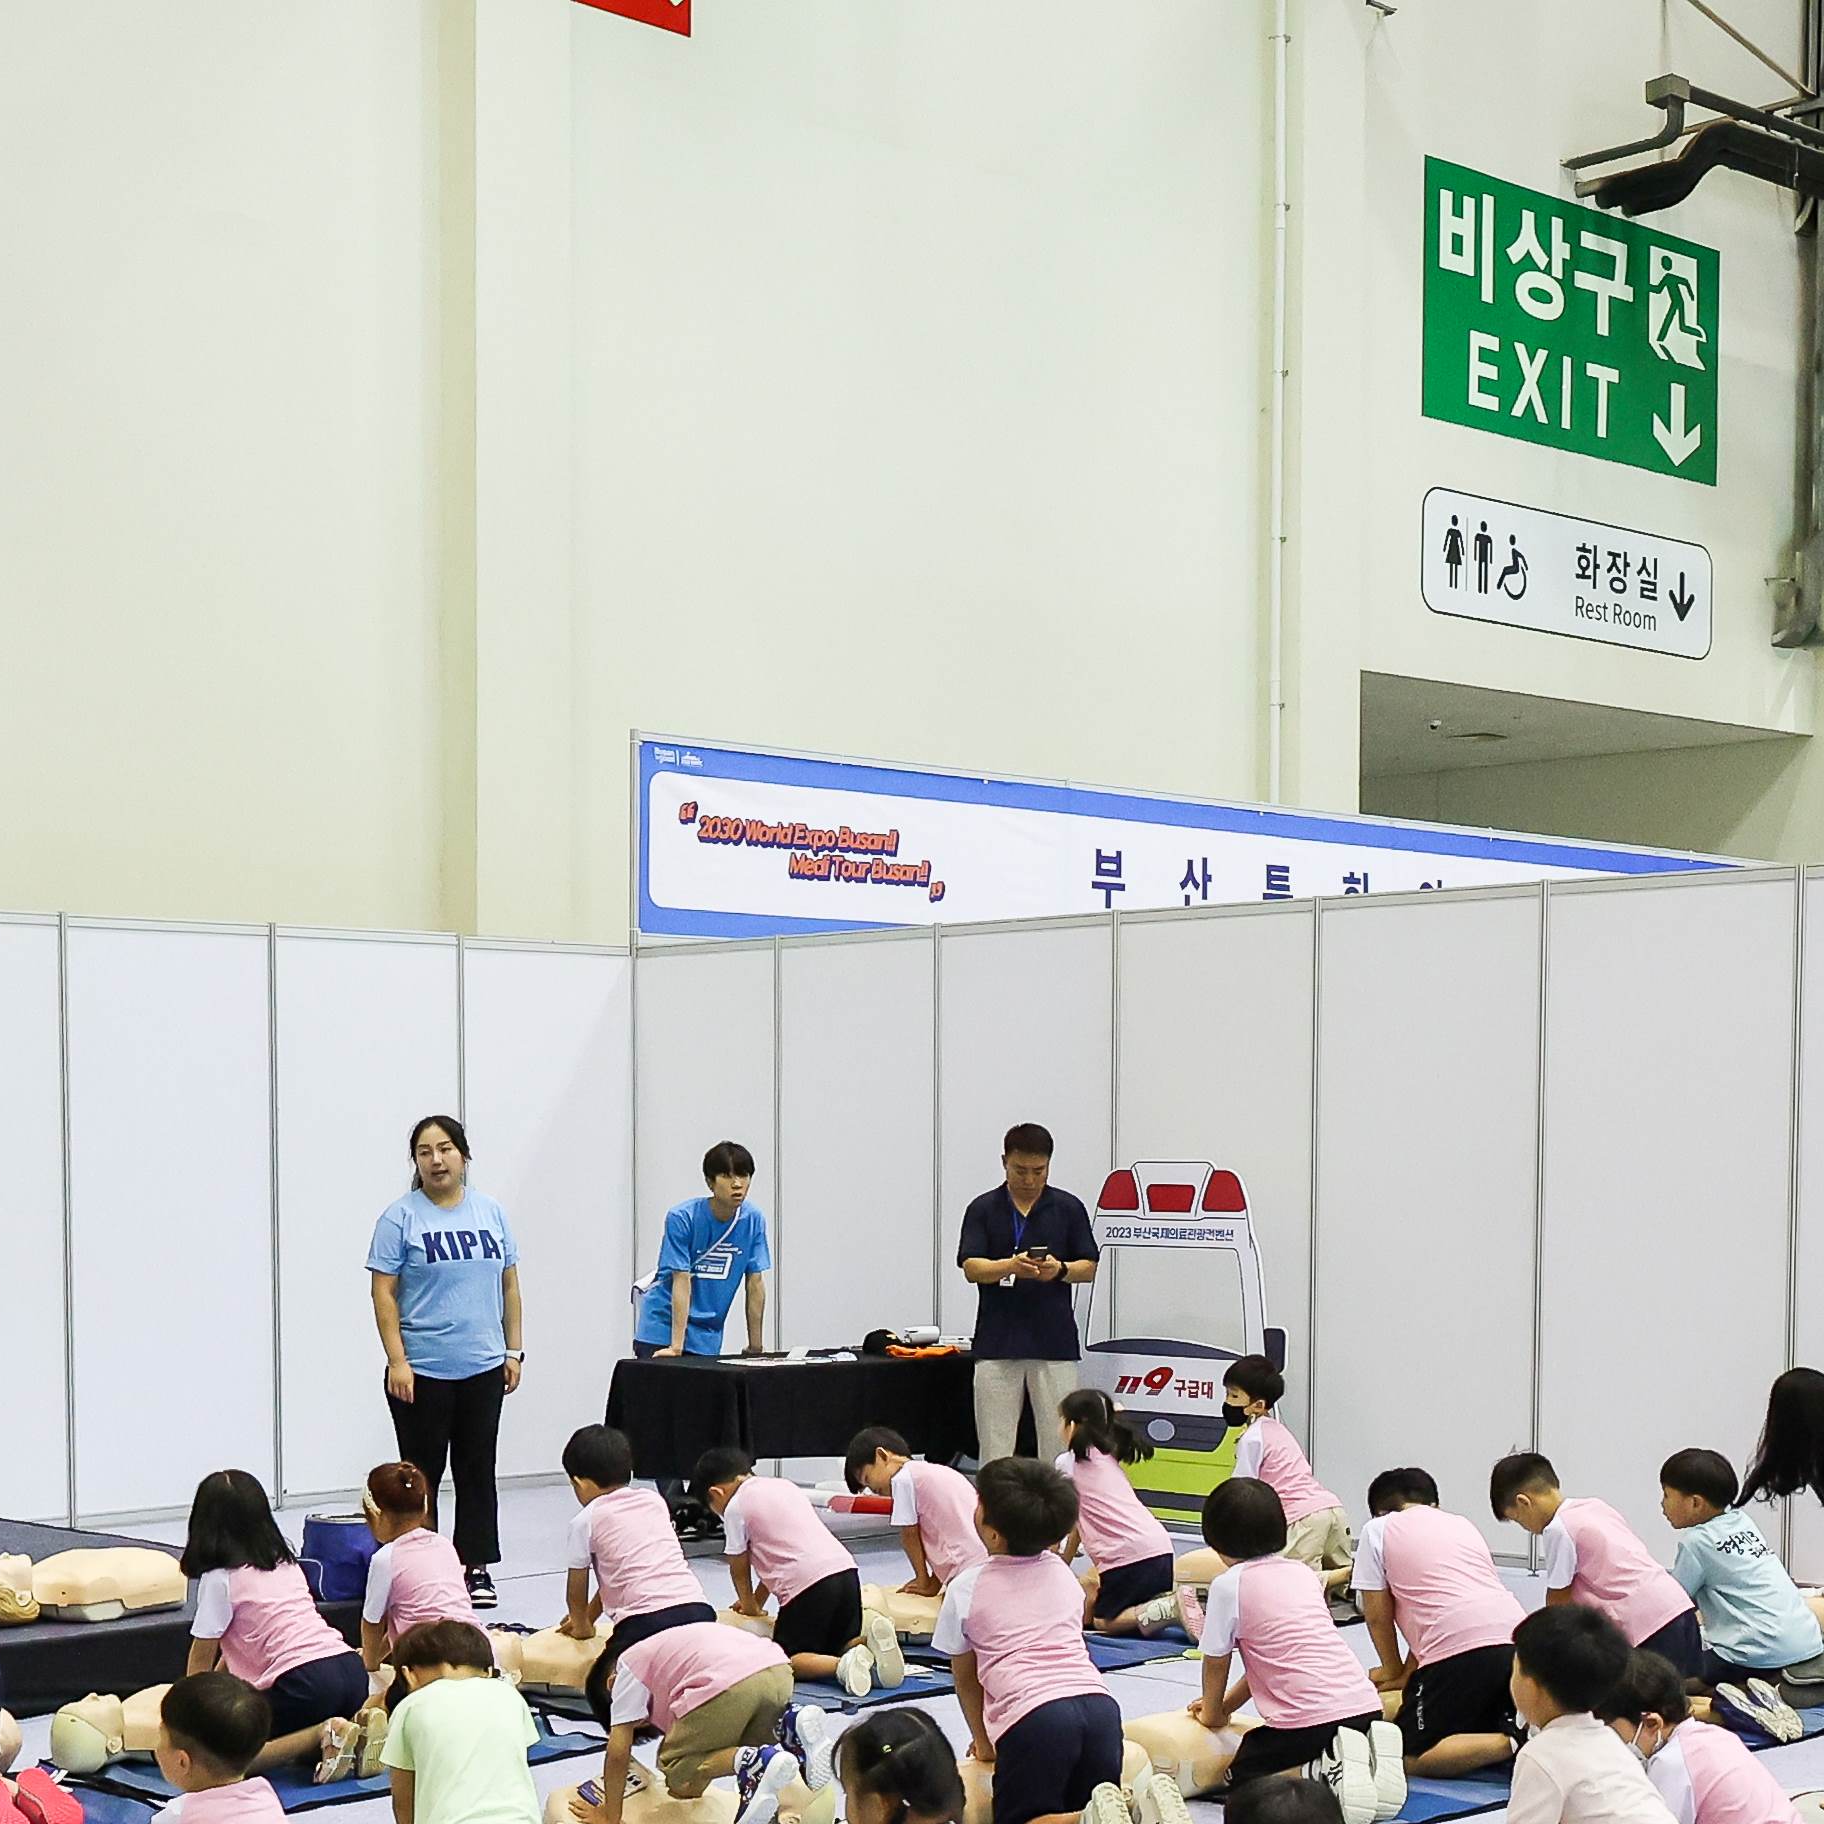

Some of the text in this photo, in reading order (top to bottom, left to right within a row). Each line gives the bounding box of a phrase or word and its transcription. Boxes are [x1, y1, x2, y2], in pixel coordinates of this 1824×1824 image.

[1438, 188, 1634, 337] 비상구
[1467, 329, 1620, 439] EXIT
[1574, 542, 1659, 602] 화장실
[1574, 596, 1657, 632] Rest Room
[697, 815, 744, 845] 2030
[744, 819, 793, 849] World
[793, 823, 837, 857] Expo
[788, 852, 831, 882] Medi
[832, 854, 870, 883] Tour
[421, 1229, 502, 1265] KIPA
[1105, 1226, 1132, 1239] 2023
[1114, 1366, 1214, 1399] 119 구급대
